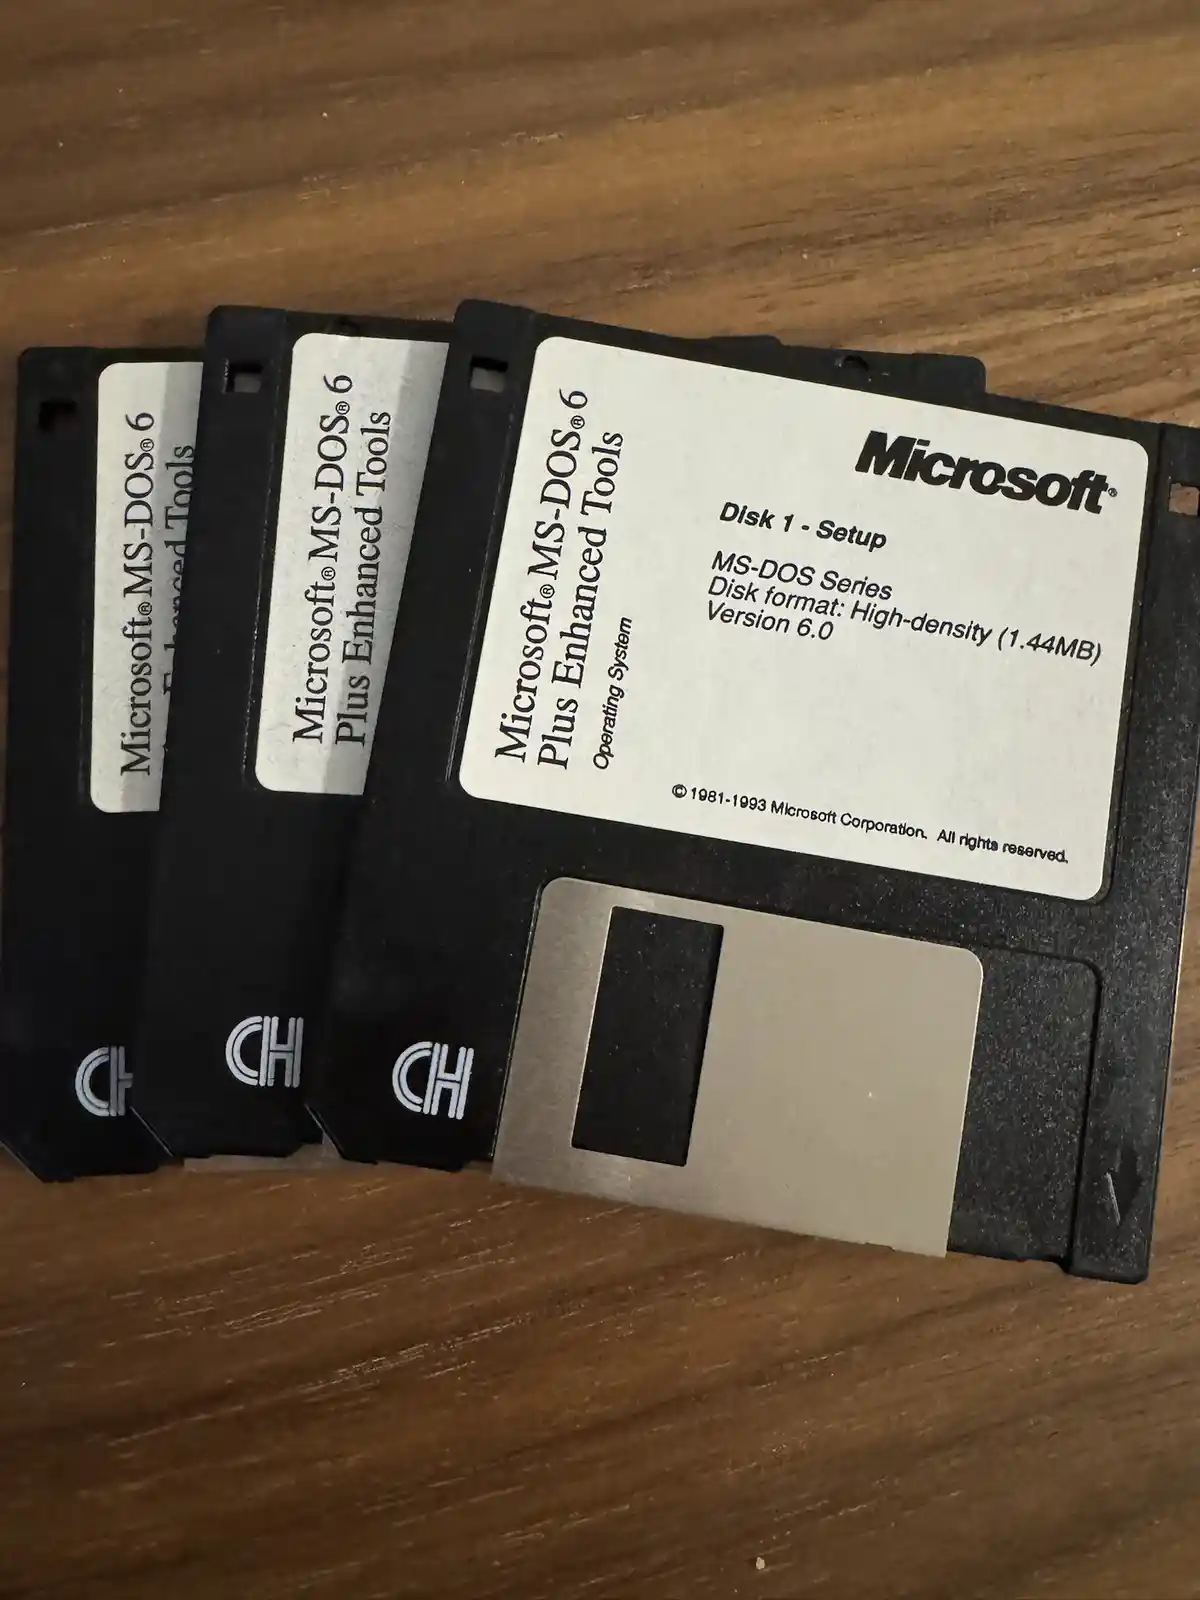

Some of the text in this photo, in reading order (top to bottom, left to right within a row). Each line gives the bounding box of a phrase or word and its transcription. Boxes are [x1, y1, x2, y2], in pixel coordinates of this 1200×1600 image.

[323, 374, 353, 394] 6
[559, 388, 589, 410] 6
[125, 412, 154, 432] 6
[164, 445, 195, 530] Tools
[719, 501, 775, 530] Disk
[783, 513, 795, 533] 1
[815, 519, 887, 553] Setup
[335, 411, 392, 747] Plus Enhanced Tools
[537, 431, 624, 771] Plus Enhanced Tools
[711, 550, 893, 601] MS-DOS Series
[707, 575, 1102, 667] Disk format: High-density (1.44MB)
[708, 599, 834, 641] Version 6.0
[592, 616, 633, 770] Operating System
[690, 786, 767, 812] 1981-1993
[770, 799, 838, 825] Microsoft
[839, 812, 928, 840] Corporation.
[936, 828, 957, 845] All
[959, 832, 999, 852] rights
[1002, 842, 1069, 864] reserved.
